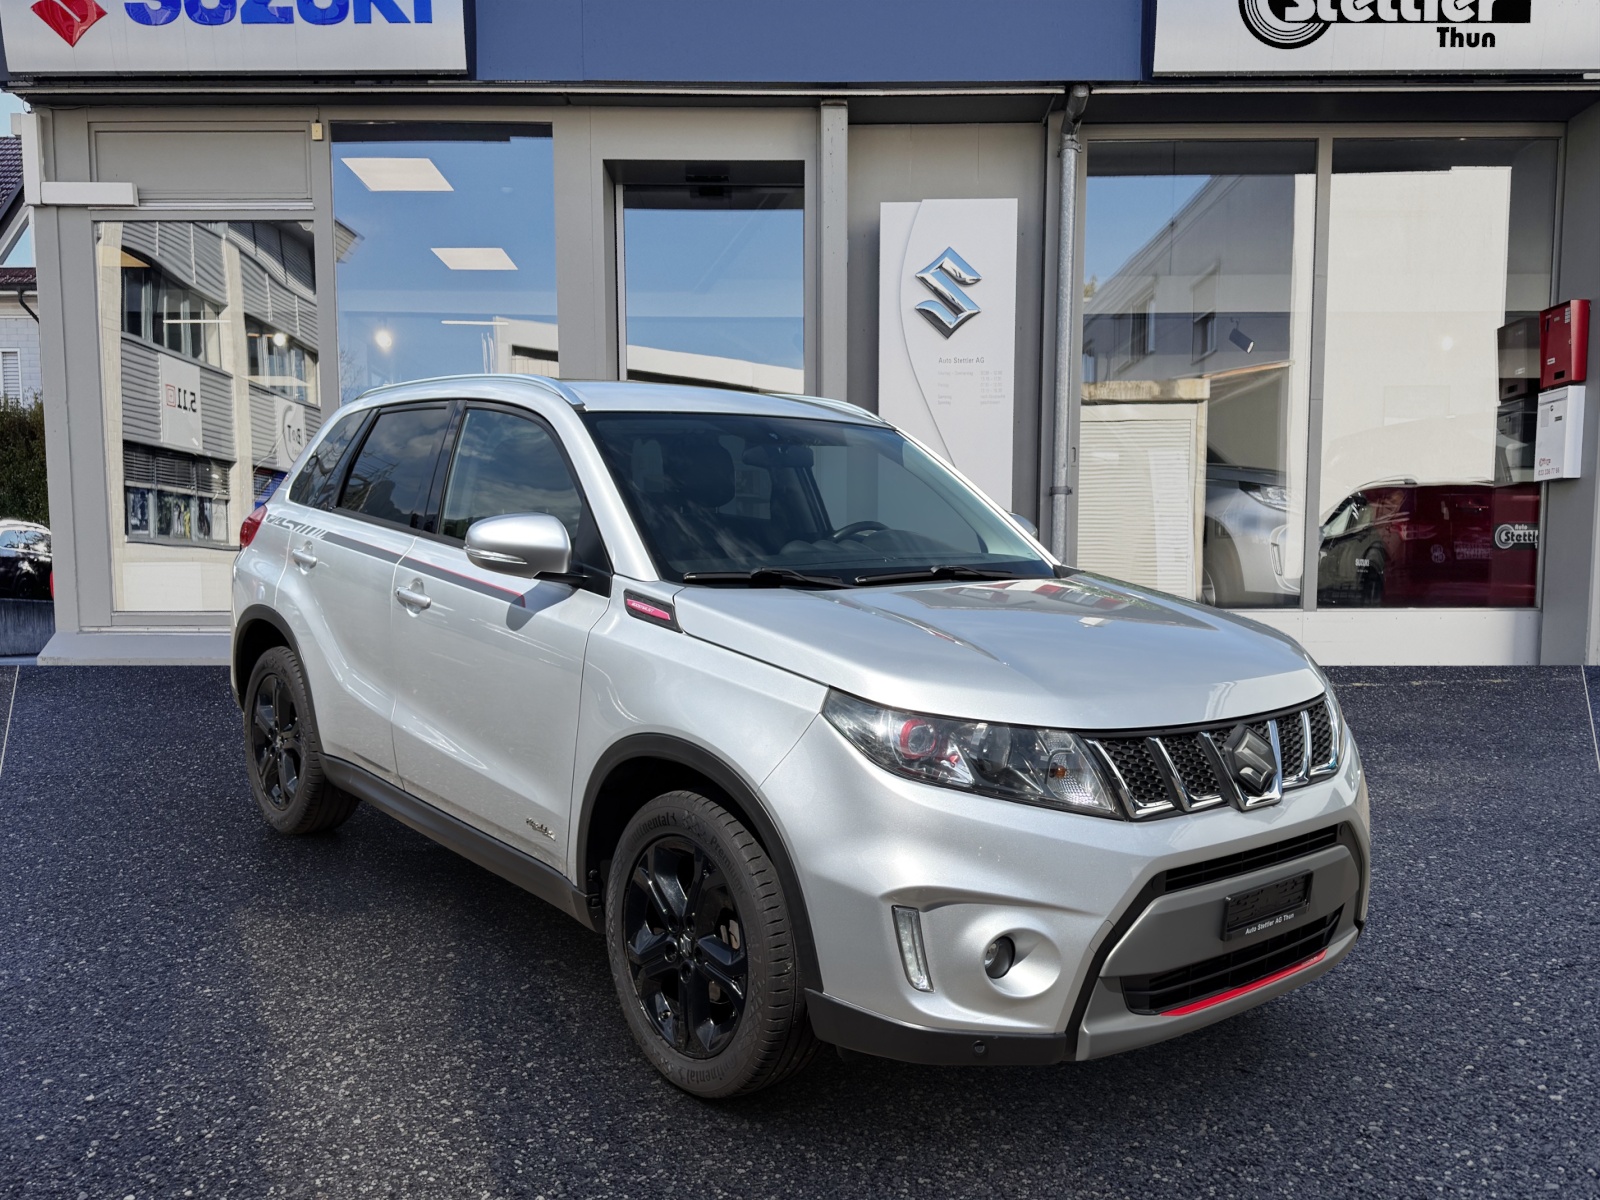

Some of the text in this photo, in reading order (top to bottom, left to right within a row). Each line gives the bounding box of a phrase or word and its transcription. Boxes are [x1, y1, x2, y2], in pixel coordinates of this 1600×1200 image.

[1436, 27, 1496, 48] Thun
[938, 356, 985, 364] Auto Stettler AG
[1245, 913, 1295, 935] Auto Stettler AG Thun
